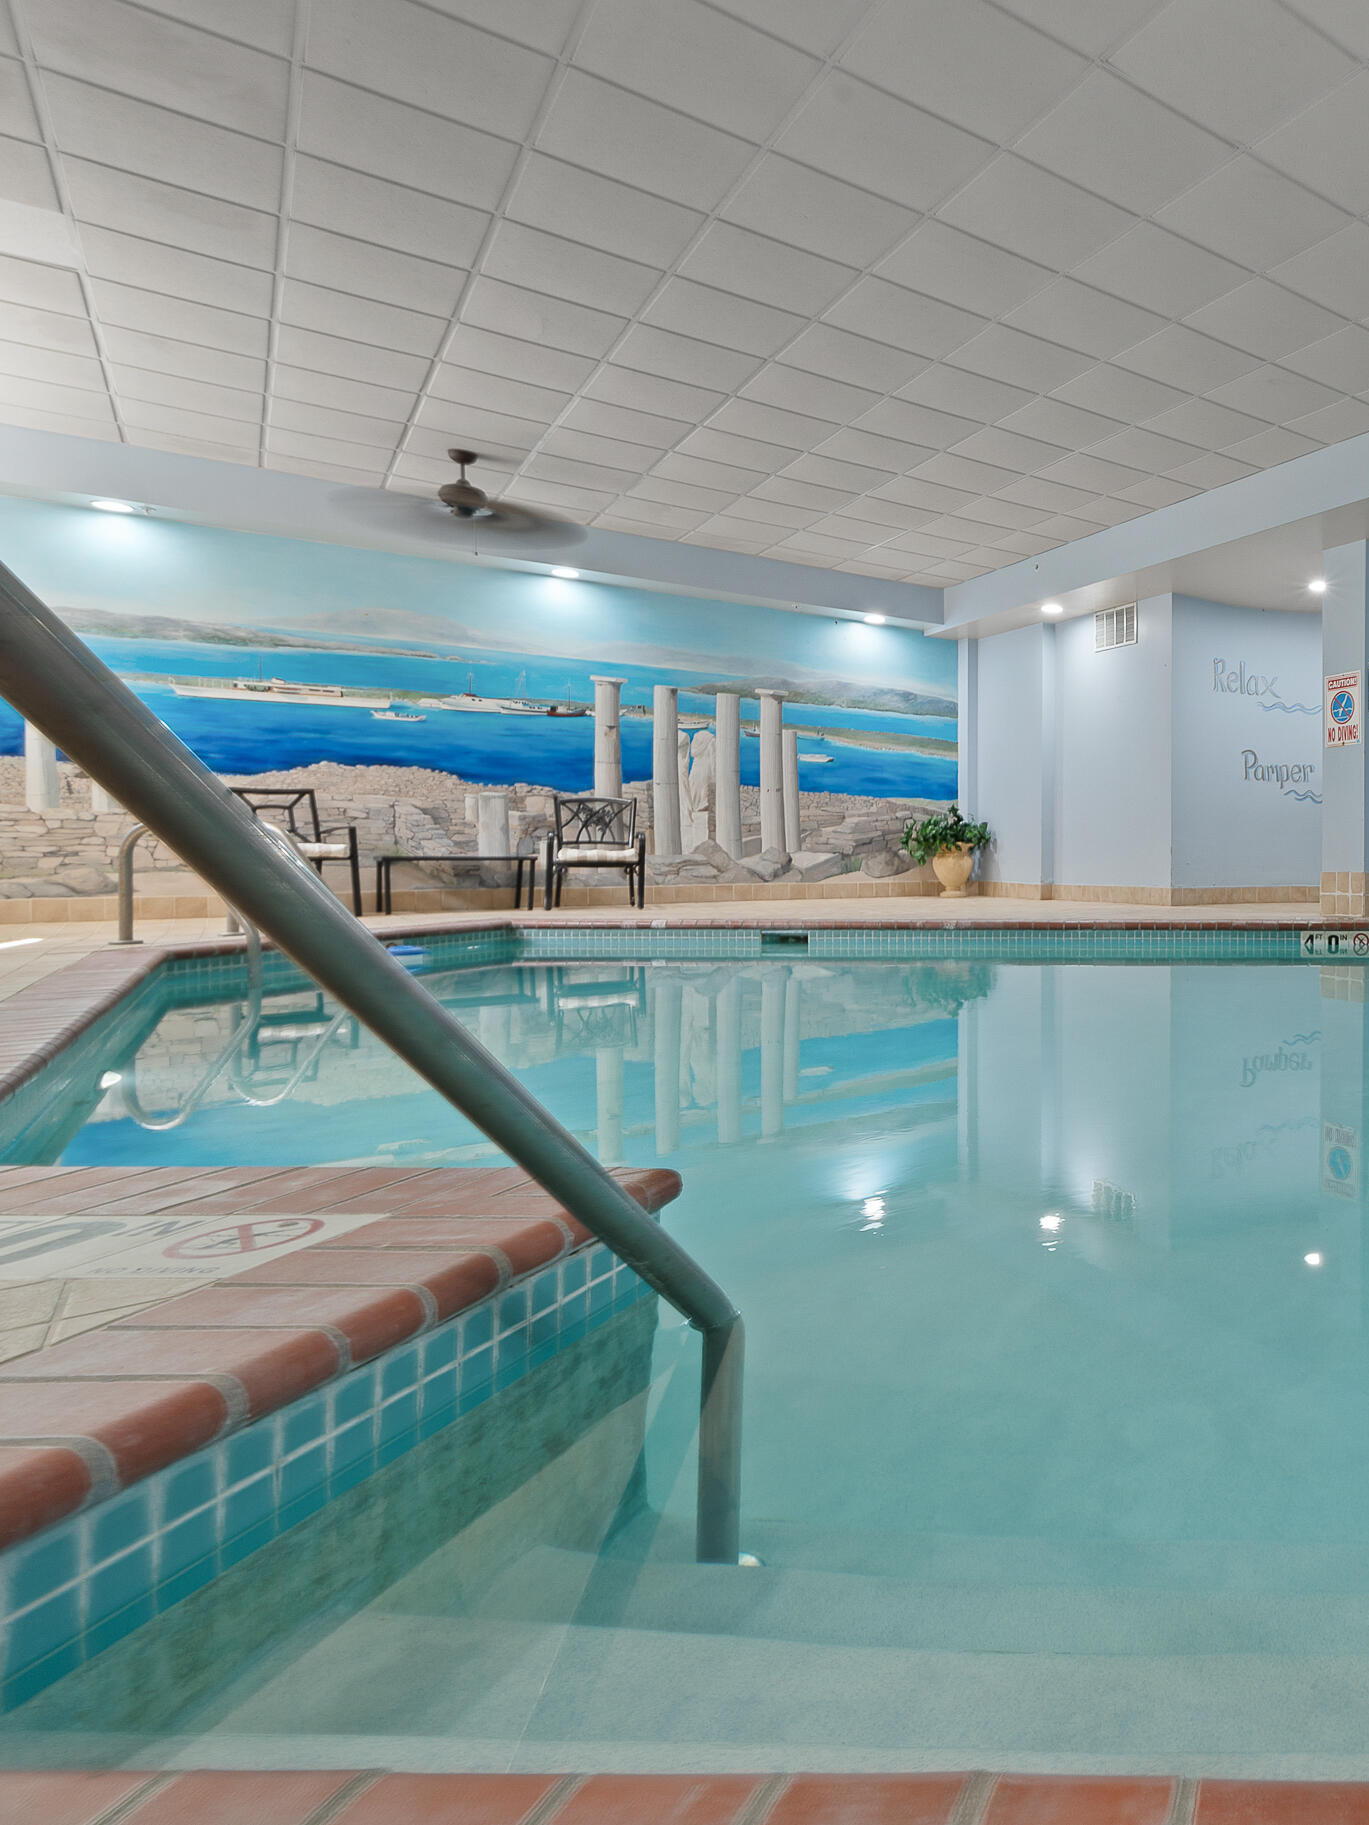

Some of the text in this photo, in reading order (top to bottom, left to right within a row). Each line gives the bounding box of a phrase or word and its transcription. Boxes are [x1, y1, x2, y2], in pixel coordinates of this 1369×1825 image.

[1213, 657, 1281, 699] Relax
[1328, 678, 1357, 689] CAUTION!
[1328, 725, 1358, 742] NO DIVING!
[1240, 749, 1315, 789] Pamper
